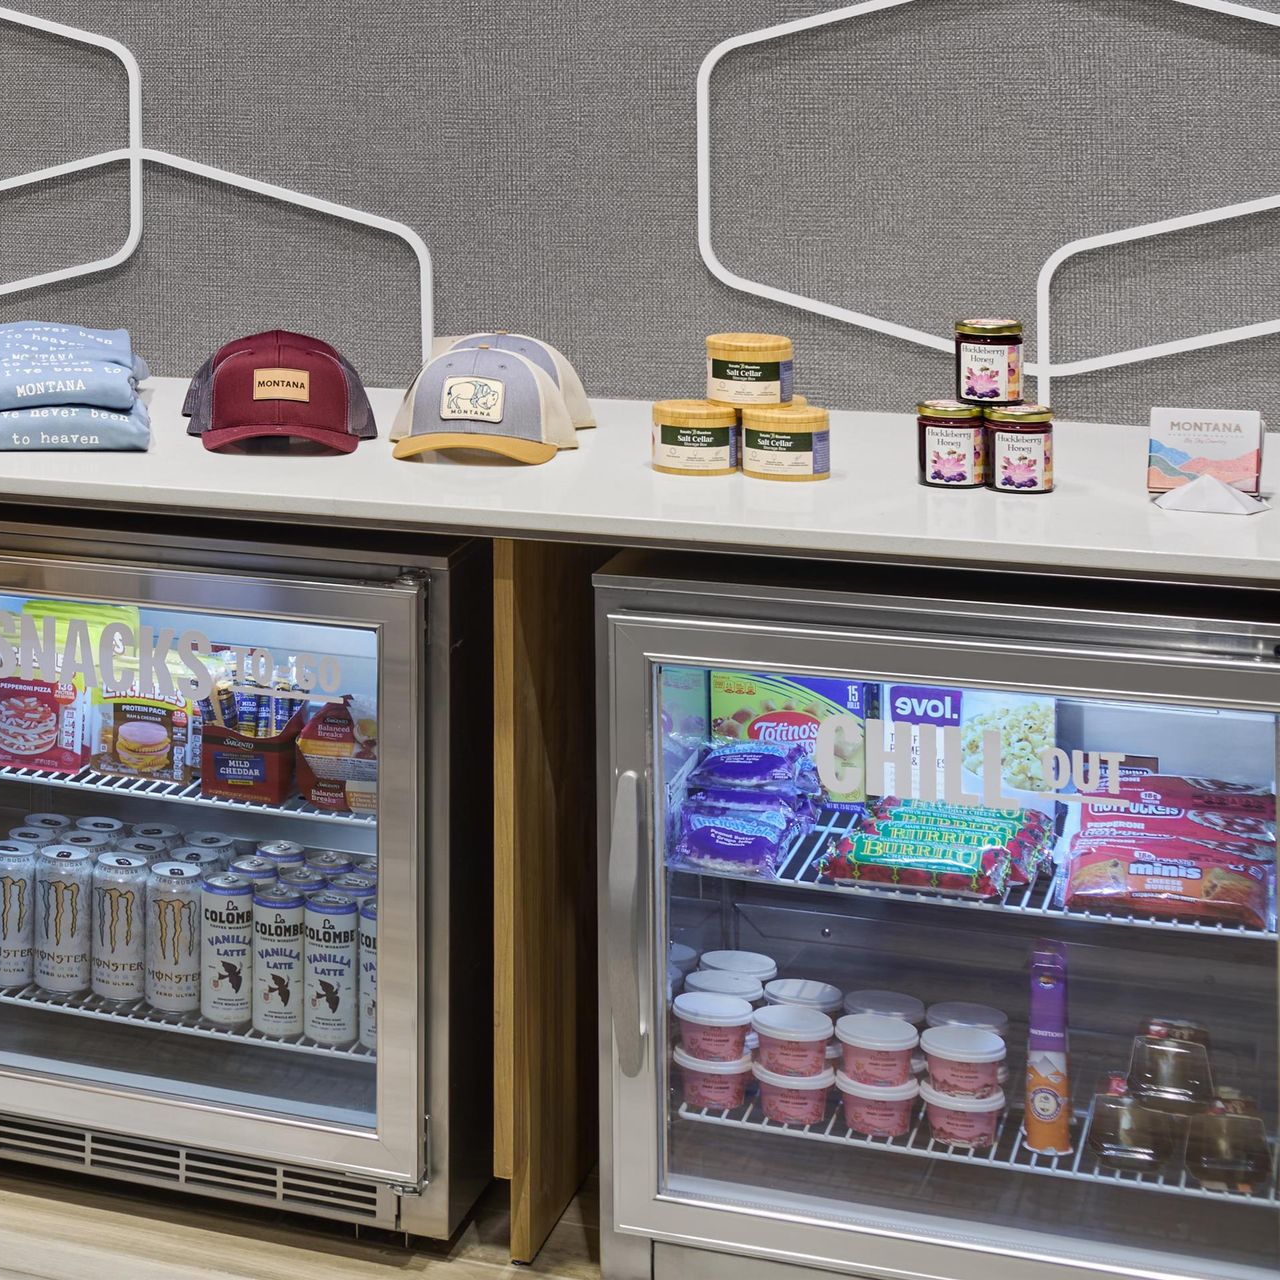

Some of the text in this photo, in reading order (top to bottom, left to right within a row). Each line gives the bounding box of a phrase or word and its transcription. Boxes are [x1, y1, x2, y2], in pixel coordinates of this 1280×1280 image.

[961, 343, 1007, 357] Huckleberry
[970, 355, 995, 366] Honey
[726, 368, 763, 378] Salt Cellar
[15, 378, 88, 399] MONTANA
[256, 379, 306, 391] MONTANA
[29, 406, 130, 423] never been
[450, 408, 492, 418] MONTANA
[926, 427, 973, 440] Huckleberry
[1168, 420, 1244, 434] MONTANA
[11, 431, 100, 446] to heaven
[677, 434, 714, 444] Salt Cellar
[757, 438, 794, 448] Salt Cellar
[936, 437, 962, 450] Honey
[996, 433, 1043, 447] Huckleberry
[1006, 443, 1033, 455] Honey
[232, 645, 342, 694] TO-GO
[0, 681, 52, 694] PEPPERONI PIZZA
[847, 684, 859, 702] 15
[121, 704, 167, 716] PROTEIN PACK
[894, 695, 959, 719] evol.
[317, 724, 351, 734] Balanced
[317, 731, 343, 739] Breaks
[753, 719, 819, 743] Totino's
[227, 759, 251, 769] MILD
[815, 712, 1126, 812] CHILL OUT
[219, 766, 261, 777] CHEDDAR
[310, 788, 344, 799] Balanced
[310, 796, 337, 804] Breaks
[710, 827, 756, 842] Peanut Butter
[862, 837, 980, 865] BURRITO
[1128, 861, 1202, 880] minis
[225, 899, 239, 912] La
[274, 913, 286, 925] La
[322, 918, 336, 931] La
[254, 922, 304, 937] COLOMBE
[304, 927, 356, 944] COLOMBE
[216, 947, 247, 957] LATTE
[257, 947, 301, 962] VANILLA
[266, 960, 294, 970] LATTE
[306, 953, 352, 969] VANILLA
[2, 966, 25, 975] ULTRA
[57, 971, 79, 980] ULTRA
[314, 966, 345, 977] LATTE
[113, 979, 135, 988] ULTRA
[173, 991, 197, 999] ULTRA
